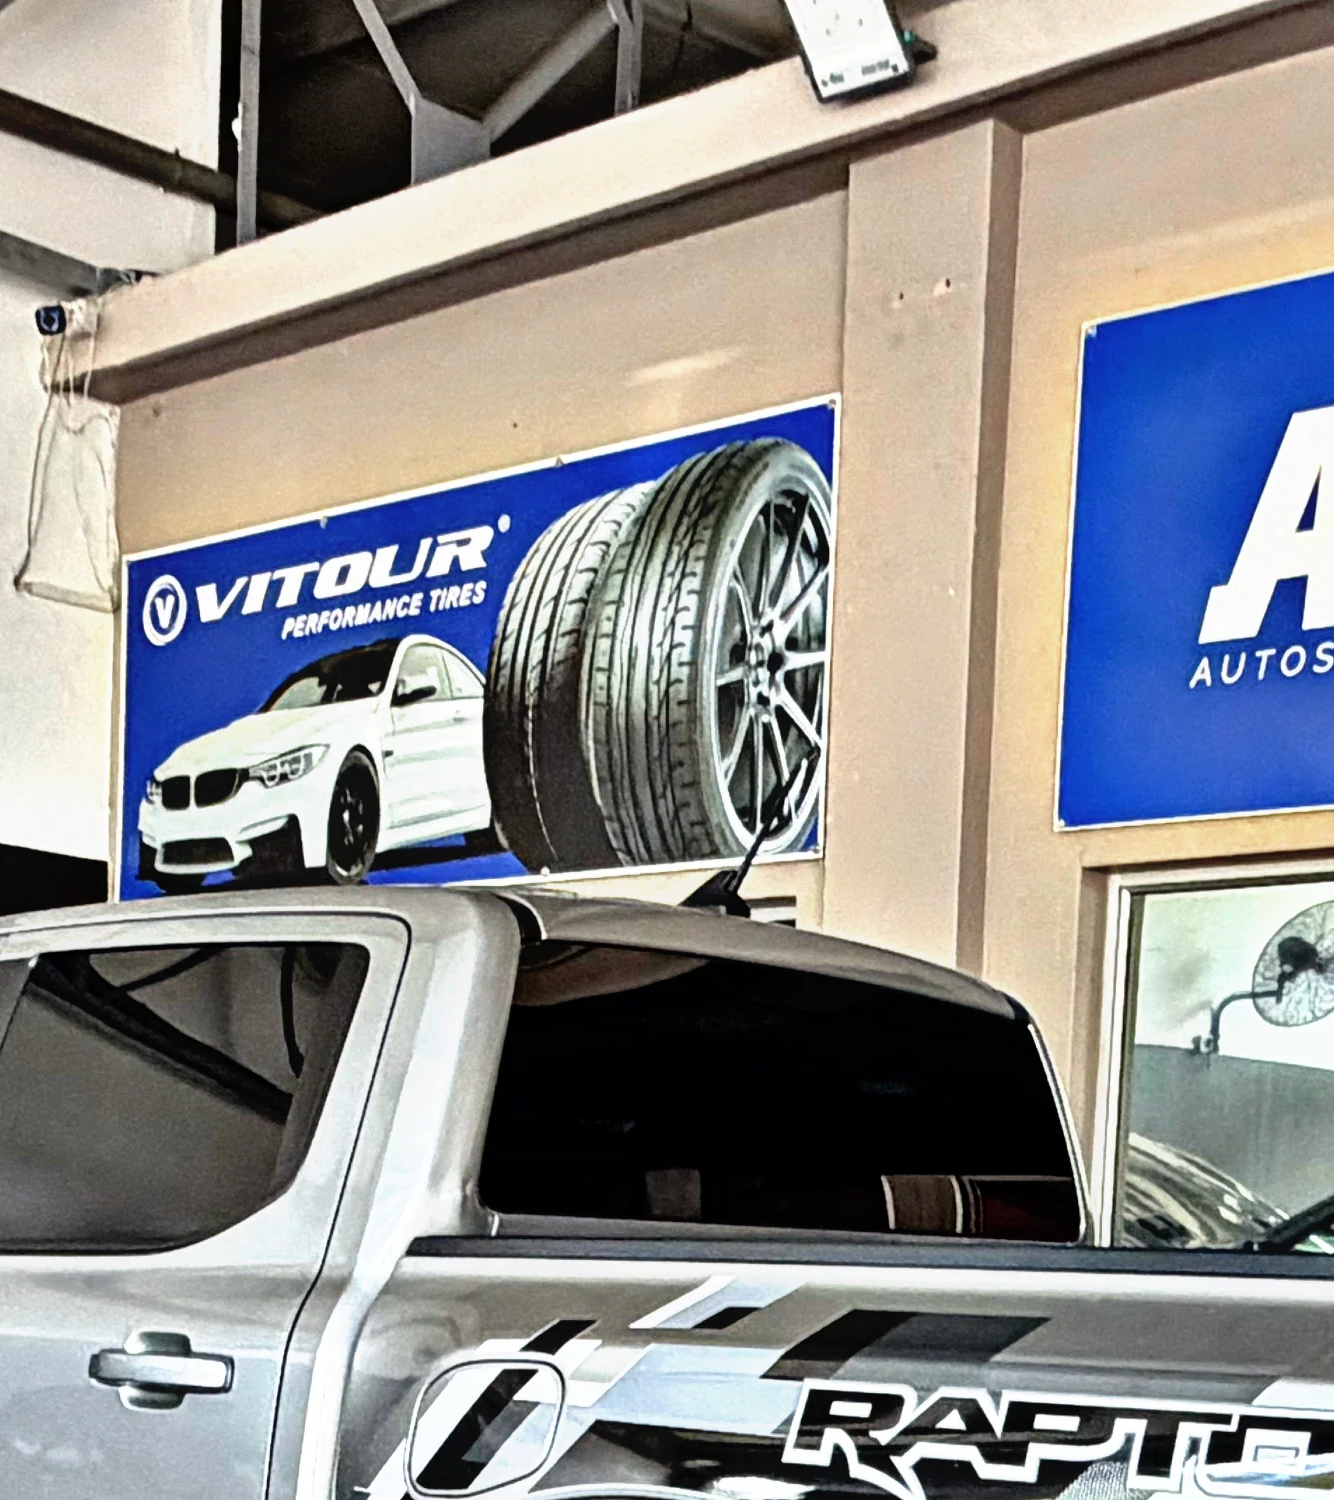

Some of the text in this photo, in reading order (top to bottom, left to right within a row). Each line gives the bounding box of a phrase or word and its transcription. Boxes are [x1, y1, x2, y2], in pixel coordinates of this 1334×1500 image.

[195, 525, 494, 624] VITOUR
[281, 580, 487, 641] PERFORMANCE TIRES
